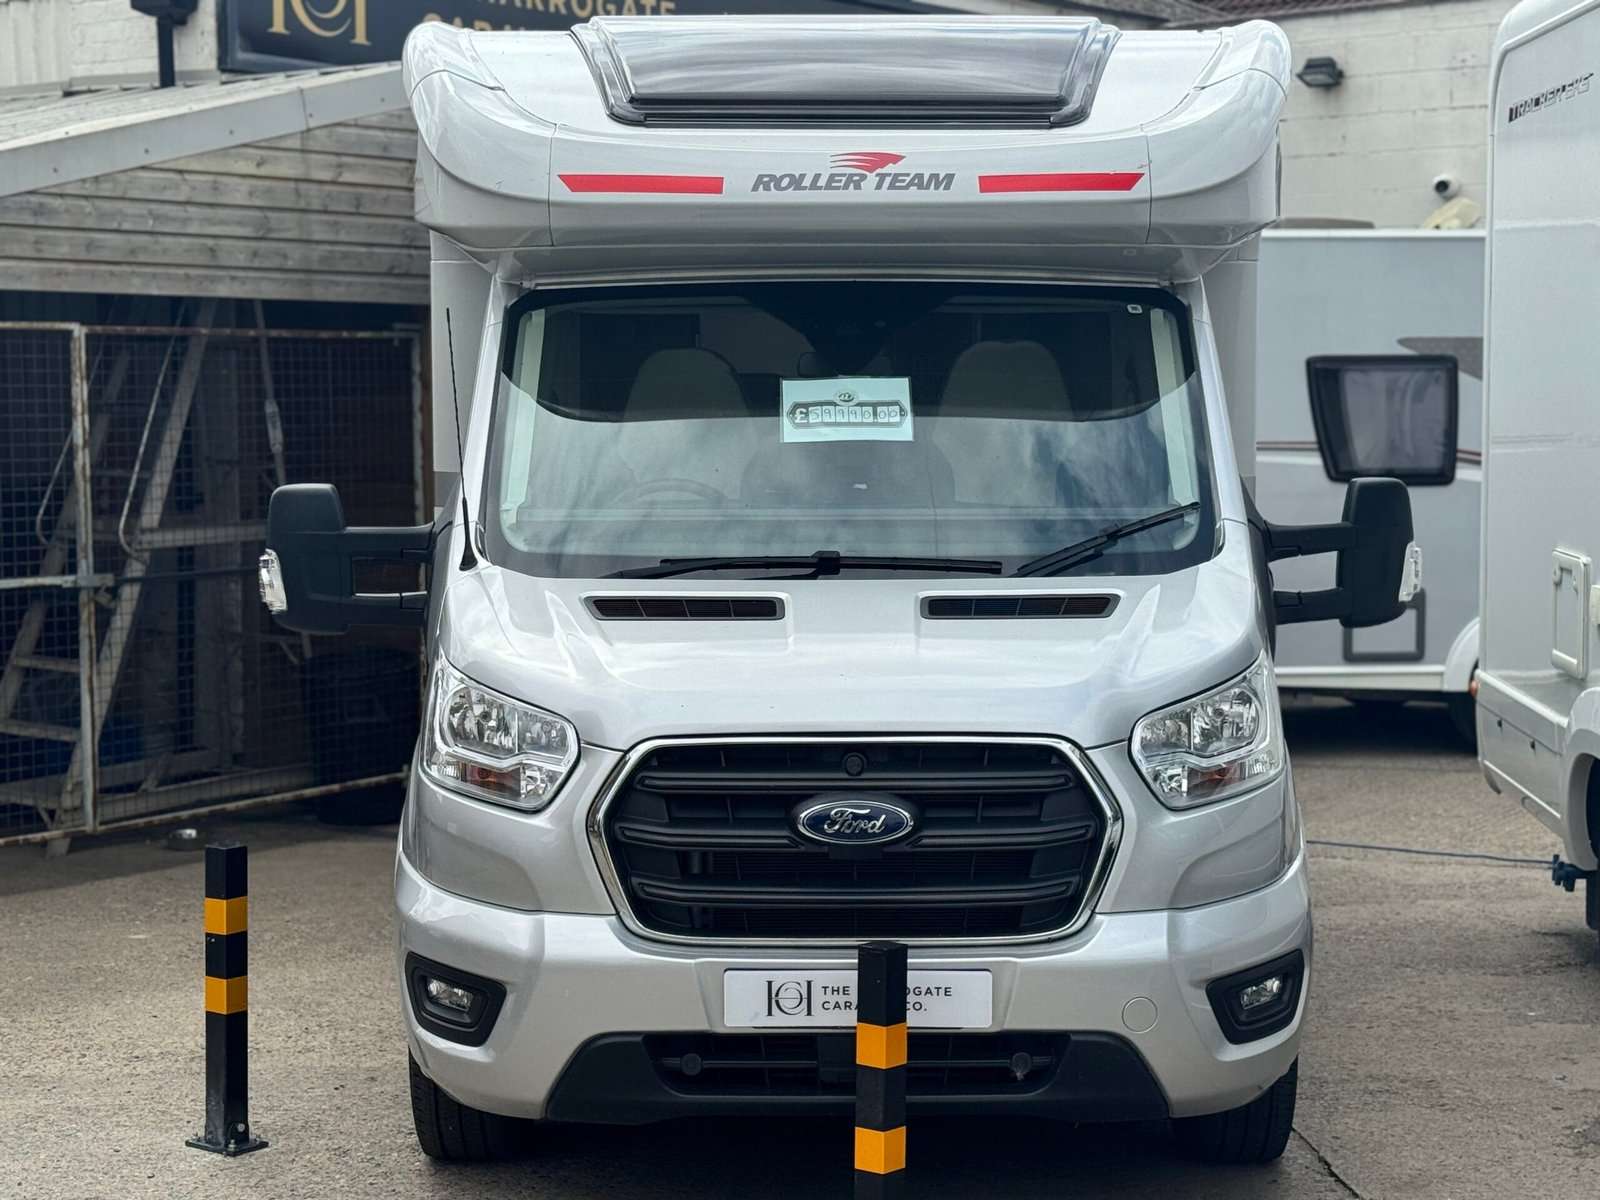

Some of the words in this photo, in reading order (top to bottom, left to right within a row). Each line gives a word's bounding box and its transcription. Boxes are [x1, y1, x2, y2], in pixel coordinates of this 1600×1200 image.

[751, 173, 867, 193] ROLLER
[874, 172, 956, 192] TEAM
[823, 807, 887, 834] Ford
[821, 985, 851, 996] THE
